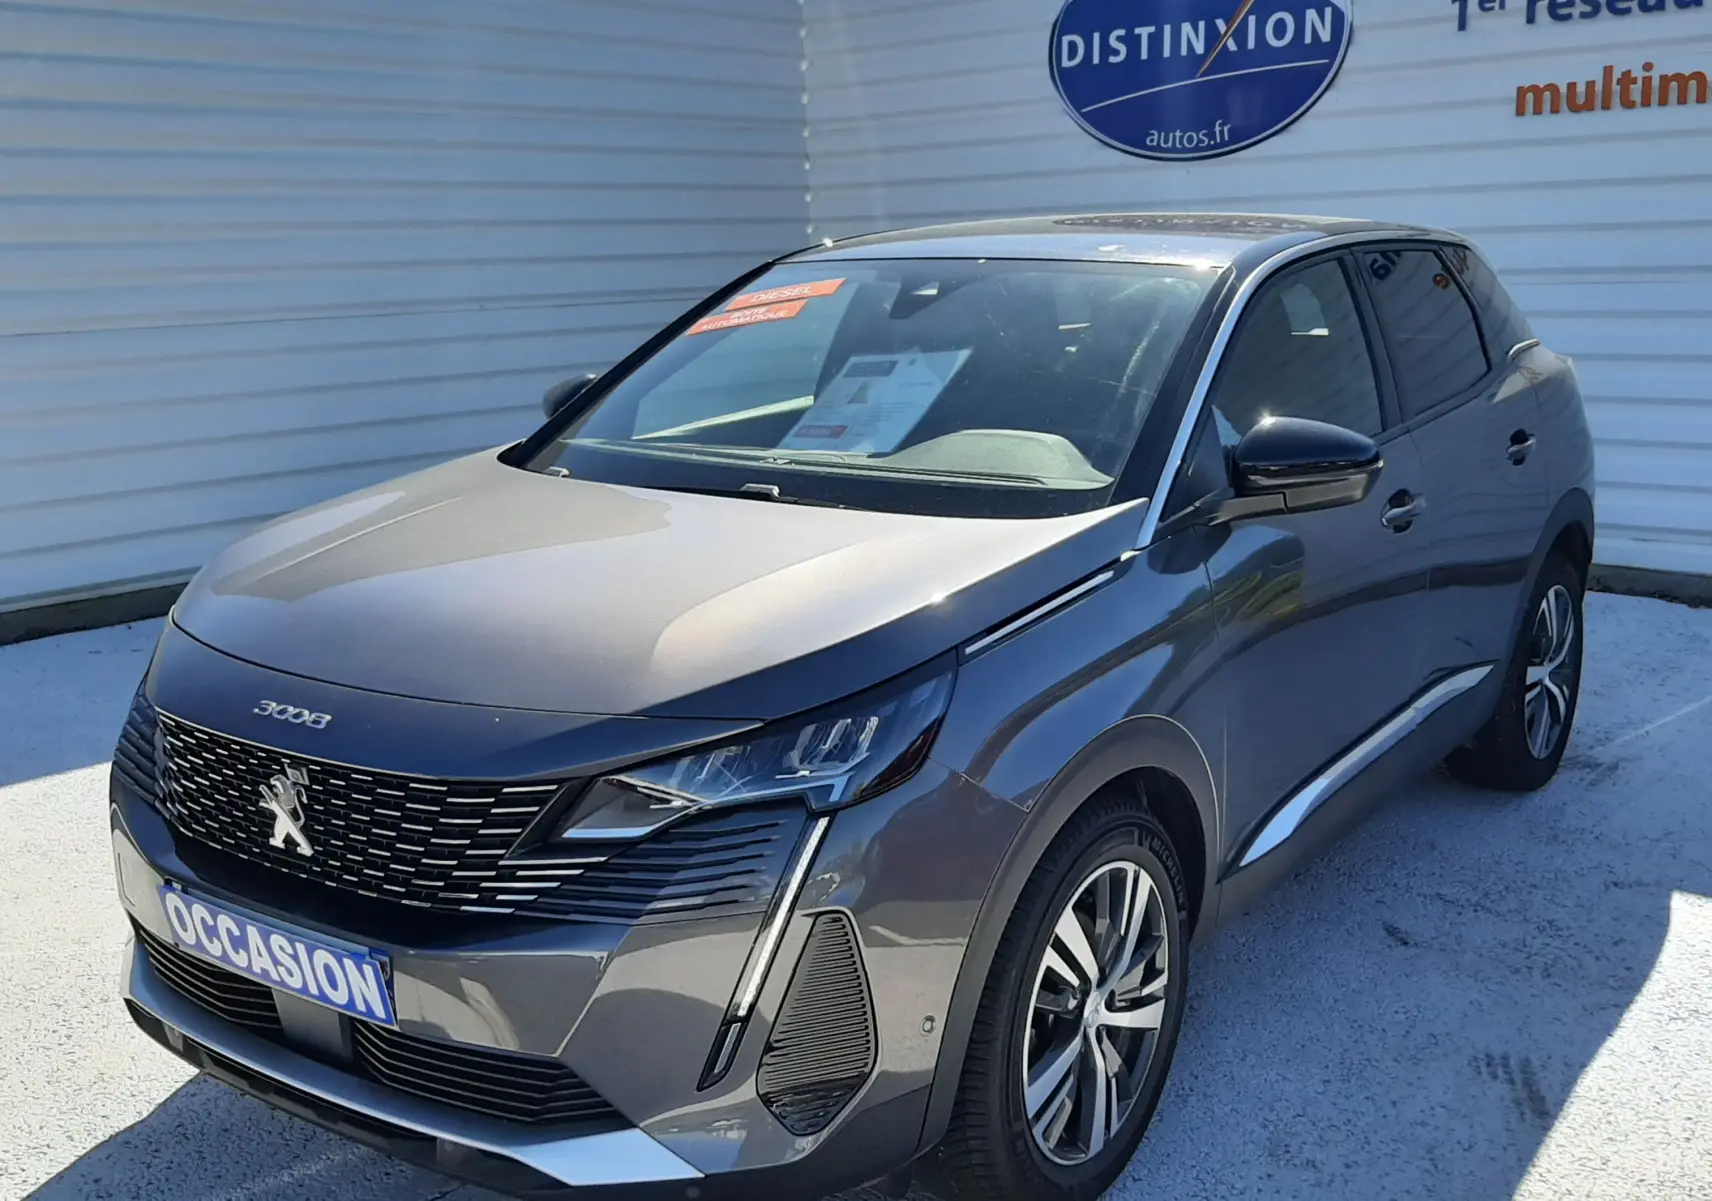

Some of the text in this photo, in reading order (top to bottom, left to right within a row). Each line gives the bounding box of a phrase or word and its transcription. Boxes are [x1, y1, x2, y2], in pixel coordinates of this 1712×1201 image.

[1061, 6, 1333, 68] DISTINXION
[1515, 62, 1708, 116] multim
[1146, 119, 1232, 149] autos.fr
[750, 286, 812, 302] DIESEL
[253, 700, 332, 729] 3008
[165, 892, 387, 1019] OCCASION
